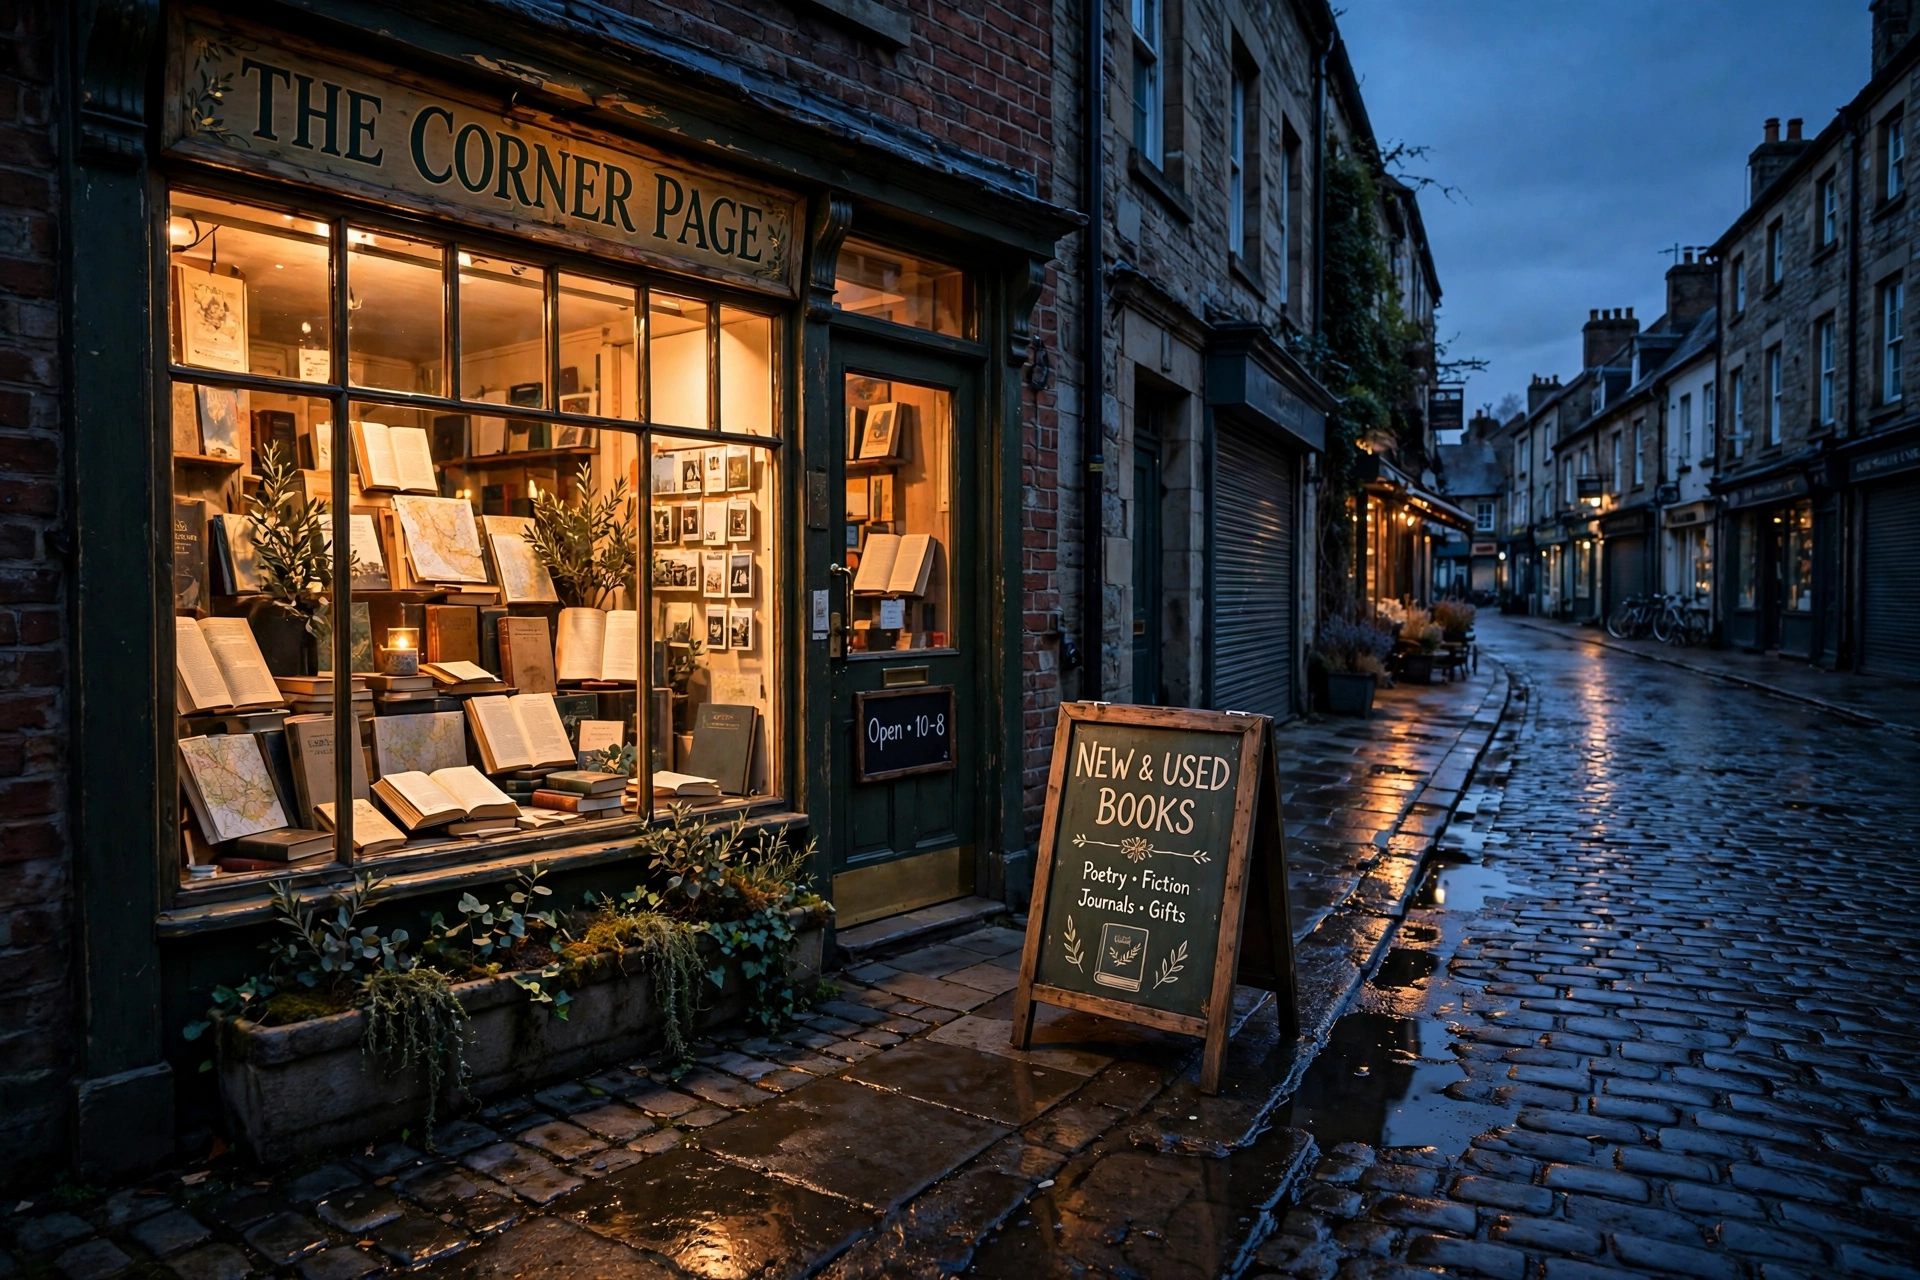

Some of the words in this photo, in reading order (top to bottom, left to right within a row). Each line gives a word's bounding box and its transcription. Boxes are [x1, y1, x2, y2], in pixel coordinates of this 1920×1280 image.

[241, 58, 384, 166] THE
[410, 105, 636, 233] CORNER
[652, 172, 763, 263] PAGE
[868, 717, 903, 751] Open
[915, 713, 945, 738] 10-8
[1075, 741, 1135, 780] NEW
[1138, 754, 1154, 782] &
[1162, 752, 1231, 792] USED
[1095, 786, 1196, 835] BOOKS
[1083, 860, 1127, 891] Poetry
[1141, 869, 1190, 895] Fiction
[1077, 888, 1135, 914] Journals
[1149, 900, 1186, 923] Gifts
